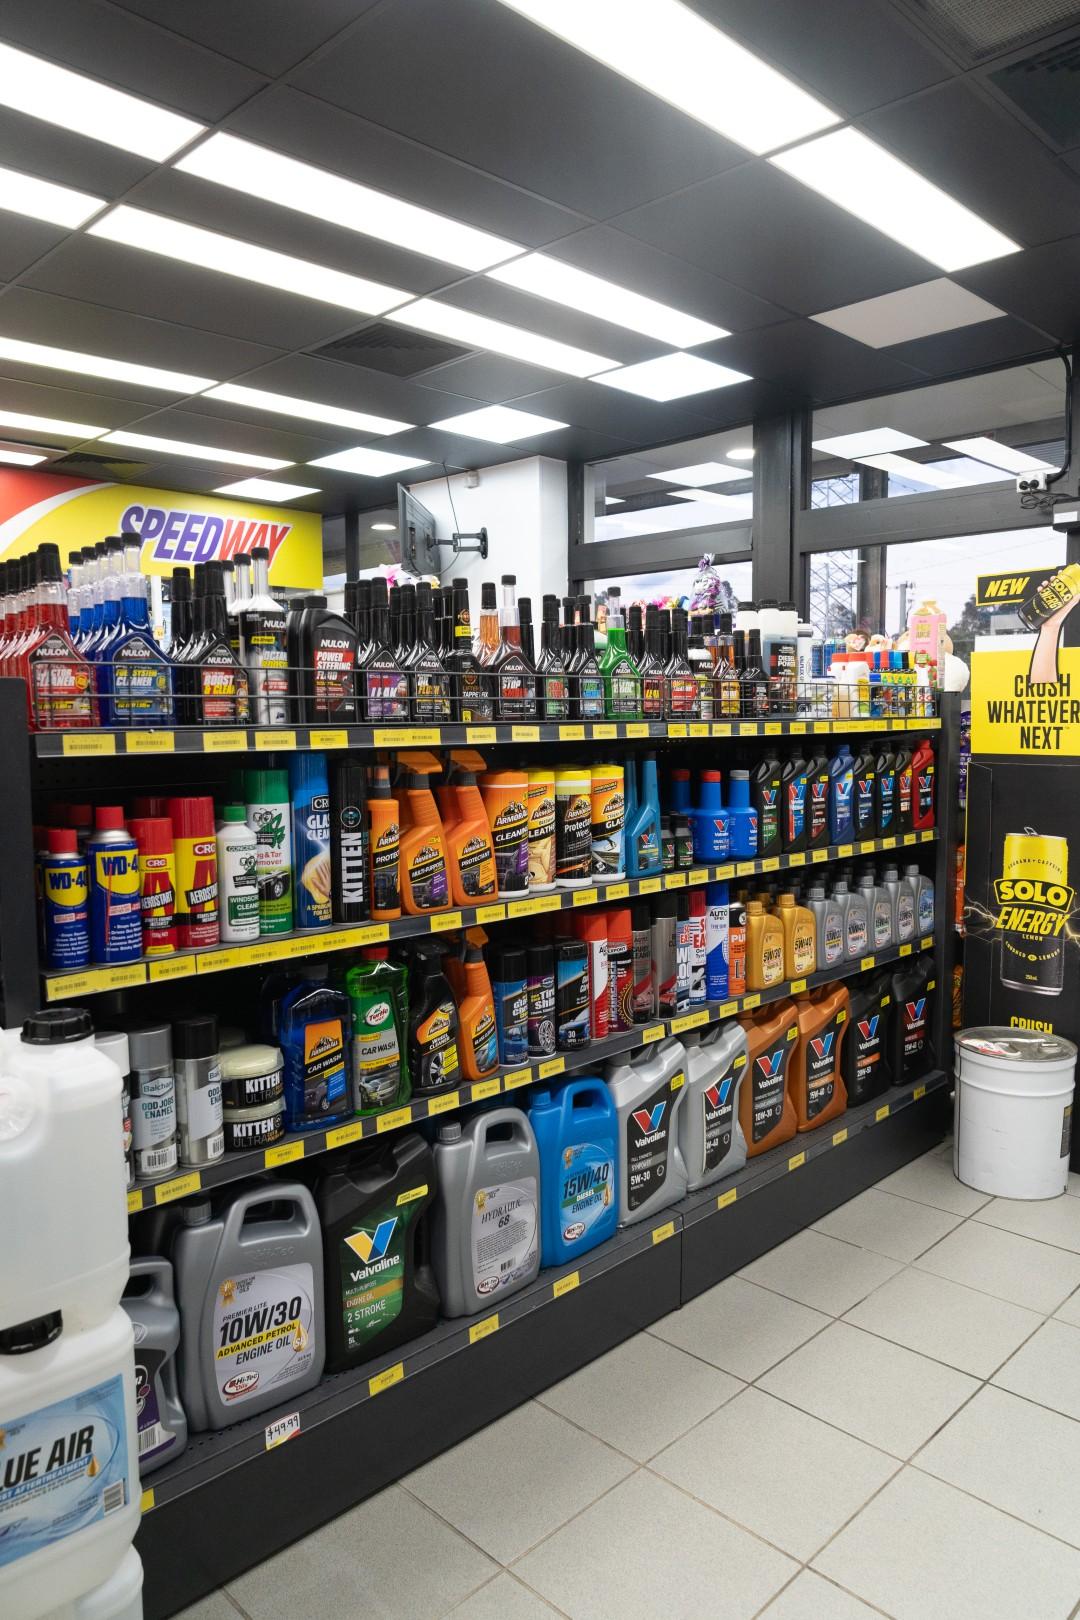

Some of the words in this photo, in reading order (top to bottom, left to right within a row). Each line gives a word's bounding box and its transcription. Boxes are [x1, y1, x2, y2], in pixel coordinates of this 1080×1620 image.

[120, 506, 292, 567] SPEEDWAY
[984, 577, 1030, 598] NEW
[1051, 579, 1073, 602] SOLO
[321, 639, 349, 648] NULON
[36, 648, 69, 656] NULON
[121, 649, 151, 657] NULON
[316, 651, 343, 661] POWER
[207, 656, 233, 664] NULON
[316, 661, 352, 670] STEERING
[1014, 674, 1071, 698] CRUSH
[987, 701, 1080, 724] WHATEVER
[1020, 726, 1063, 750] NEXT
[576, 828, 589, 838] Wipes
[146, 859, 166, 867] CRC
[461, 851, 491, 866] PROTECTANT
[341, 832, 364, 903] KITTEN
[141, 891, 173, 910] AEROSTART
[999, 880, 1068, 907] SOLO
[995, 906, 1070, 937] ENERGY
[794, 936, 812, 951] 5W/40
[1022, 934, 1043, 942] LEMON
[763, 948, 782, 962] 5W/30
[369, 1008, 388, 1021] Turtle
[906, 1020, 925, 1031] Valvoline
[567, 1030, 576, 1038] 30
[361, 1046, 377, 1056] CAR
[377, 1041, 396, 1051] WASH
[429, 1037, 450, 1050] CLEANER
[858, 1037, 880, 1050] Valvoline
[308, 1064, 322, 1073] CAR
[322, 1053, 342, 1067] WASH
[811, 1056, 834, 1070] Valvoline
[246, 1072, 280, 1093] KITTEN
[758, 1074, 783, 1089] Valvoline
[142, 1100, 158, 1111] ODD
[159, 1097, 174, 1109] JOBS
[144, 1107, 173, 1119] ENAMEL
[706, 1104, 732, 1121] Valvoline
[755, 1108, 773, 1121] 10W-30
[233, 1117, 274, 1138] KITTEN
[233, 1135, 268, 1147] ULTRA
[634, 1129, 666, 1148] Valvoline
[563, 1163, 609, 1199] 15W/40
[630, 1170, 651, 1185] 5W-30
[576, 1189, 594, 1202] DIESEL
[571, 1196, 593, 1214] ENGINE
[593, 1194, 603, 1204] OIL
[498, 1214, 510, 1228] 68
[350, 1254, 400, 1282] Valvoline
[346, 1294, 366, 1308] ENGINE
[222, 1307, 253, 1323] PREMIER
[253, 1301, 268, 1312] LITE
[347, 1312, 353, 1323] 2
[354, 1299, 386, 1321] STROKE
[219, 1296, 302, 1347] 10W/30
[217, 1336, 264, 1358] ADVANCED
[265, 1322, 297, 1340] PETROL
[235, 1344, 273, 1365] ENGINE
[275, 1335, 291, 1350] OIL
[267, 1415, 299, 1440] $49.99
[46, 1425, 94, 1472] AIR
[14, 1455, 90, 1497] AFTERTREATMENT
